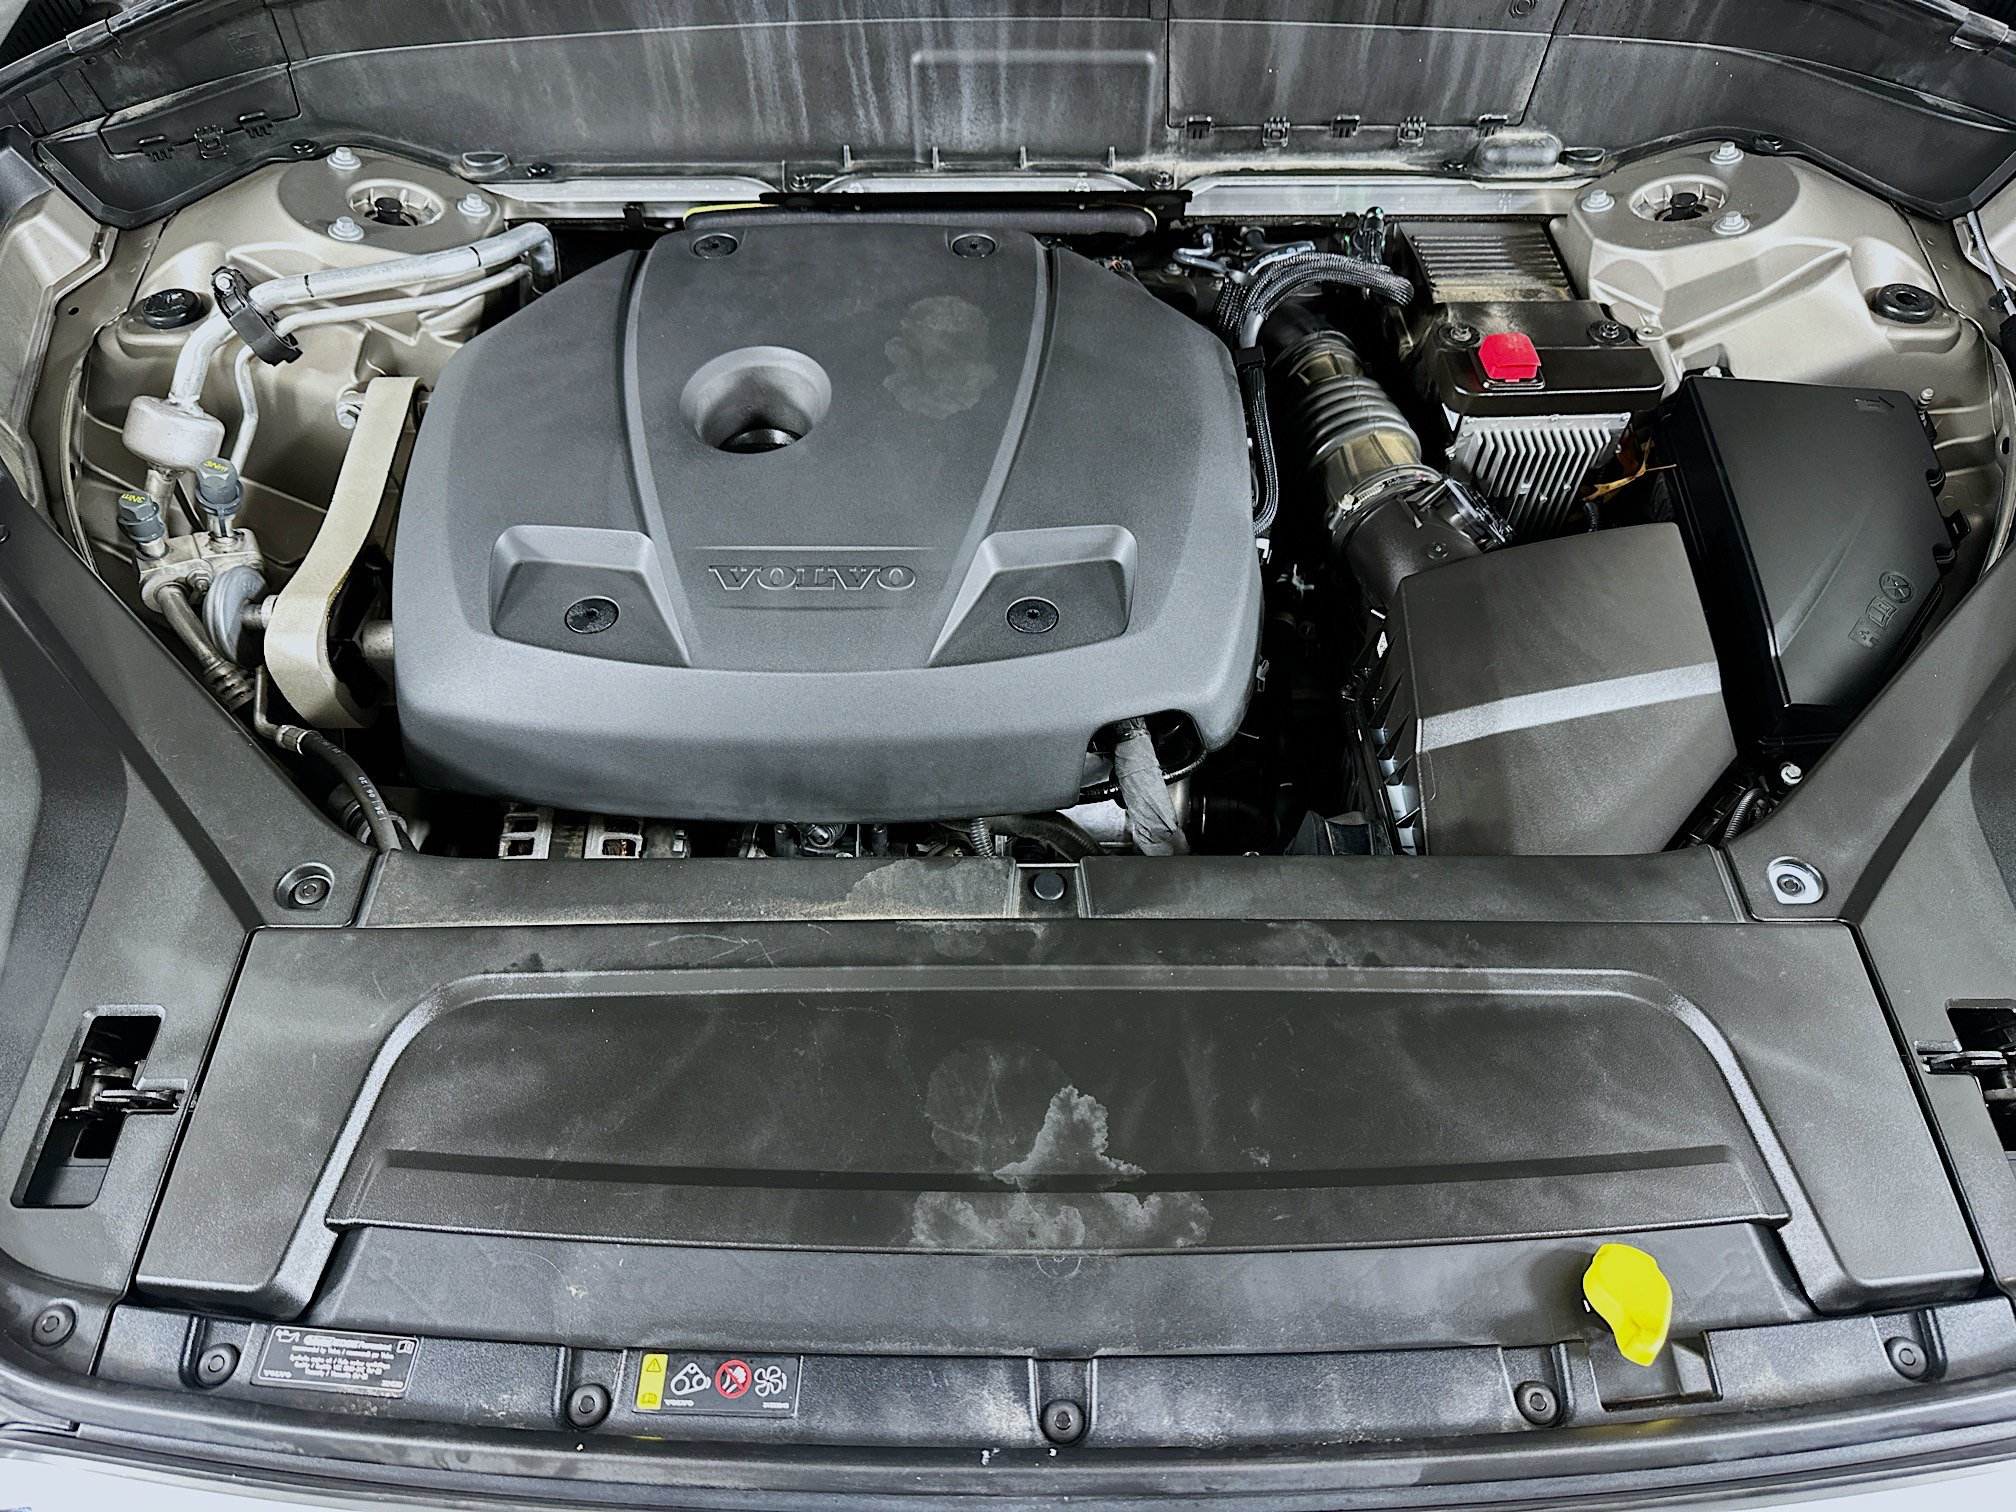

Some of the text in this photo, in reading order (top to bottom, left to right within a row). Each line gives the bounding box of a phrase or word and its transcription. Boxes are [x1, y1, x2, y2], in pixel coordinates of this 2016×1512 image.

[203, 460, 229, 472] 3Nm
[121, 493, 146, 504] 3Nm
[708, 565, 916, 590] VOLVO
